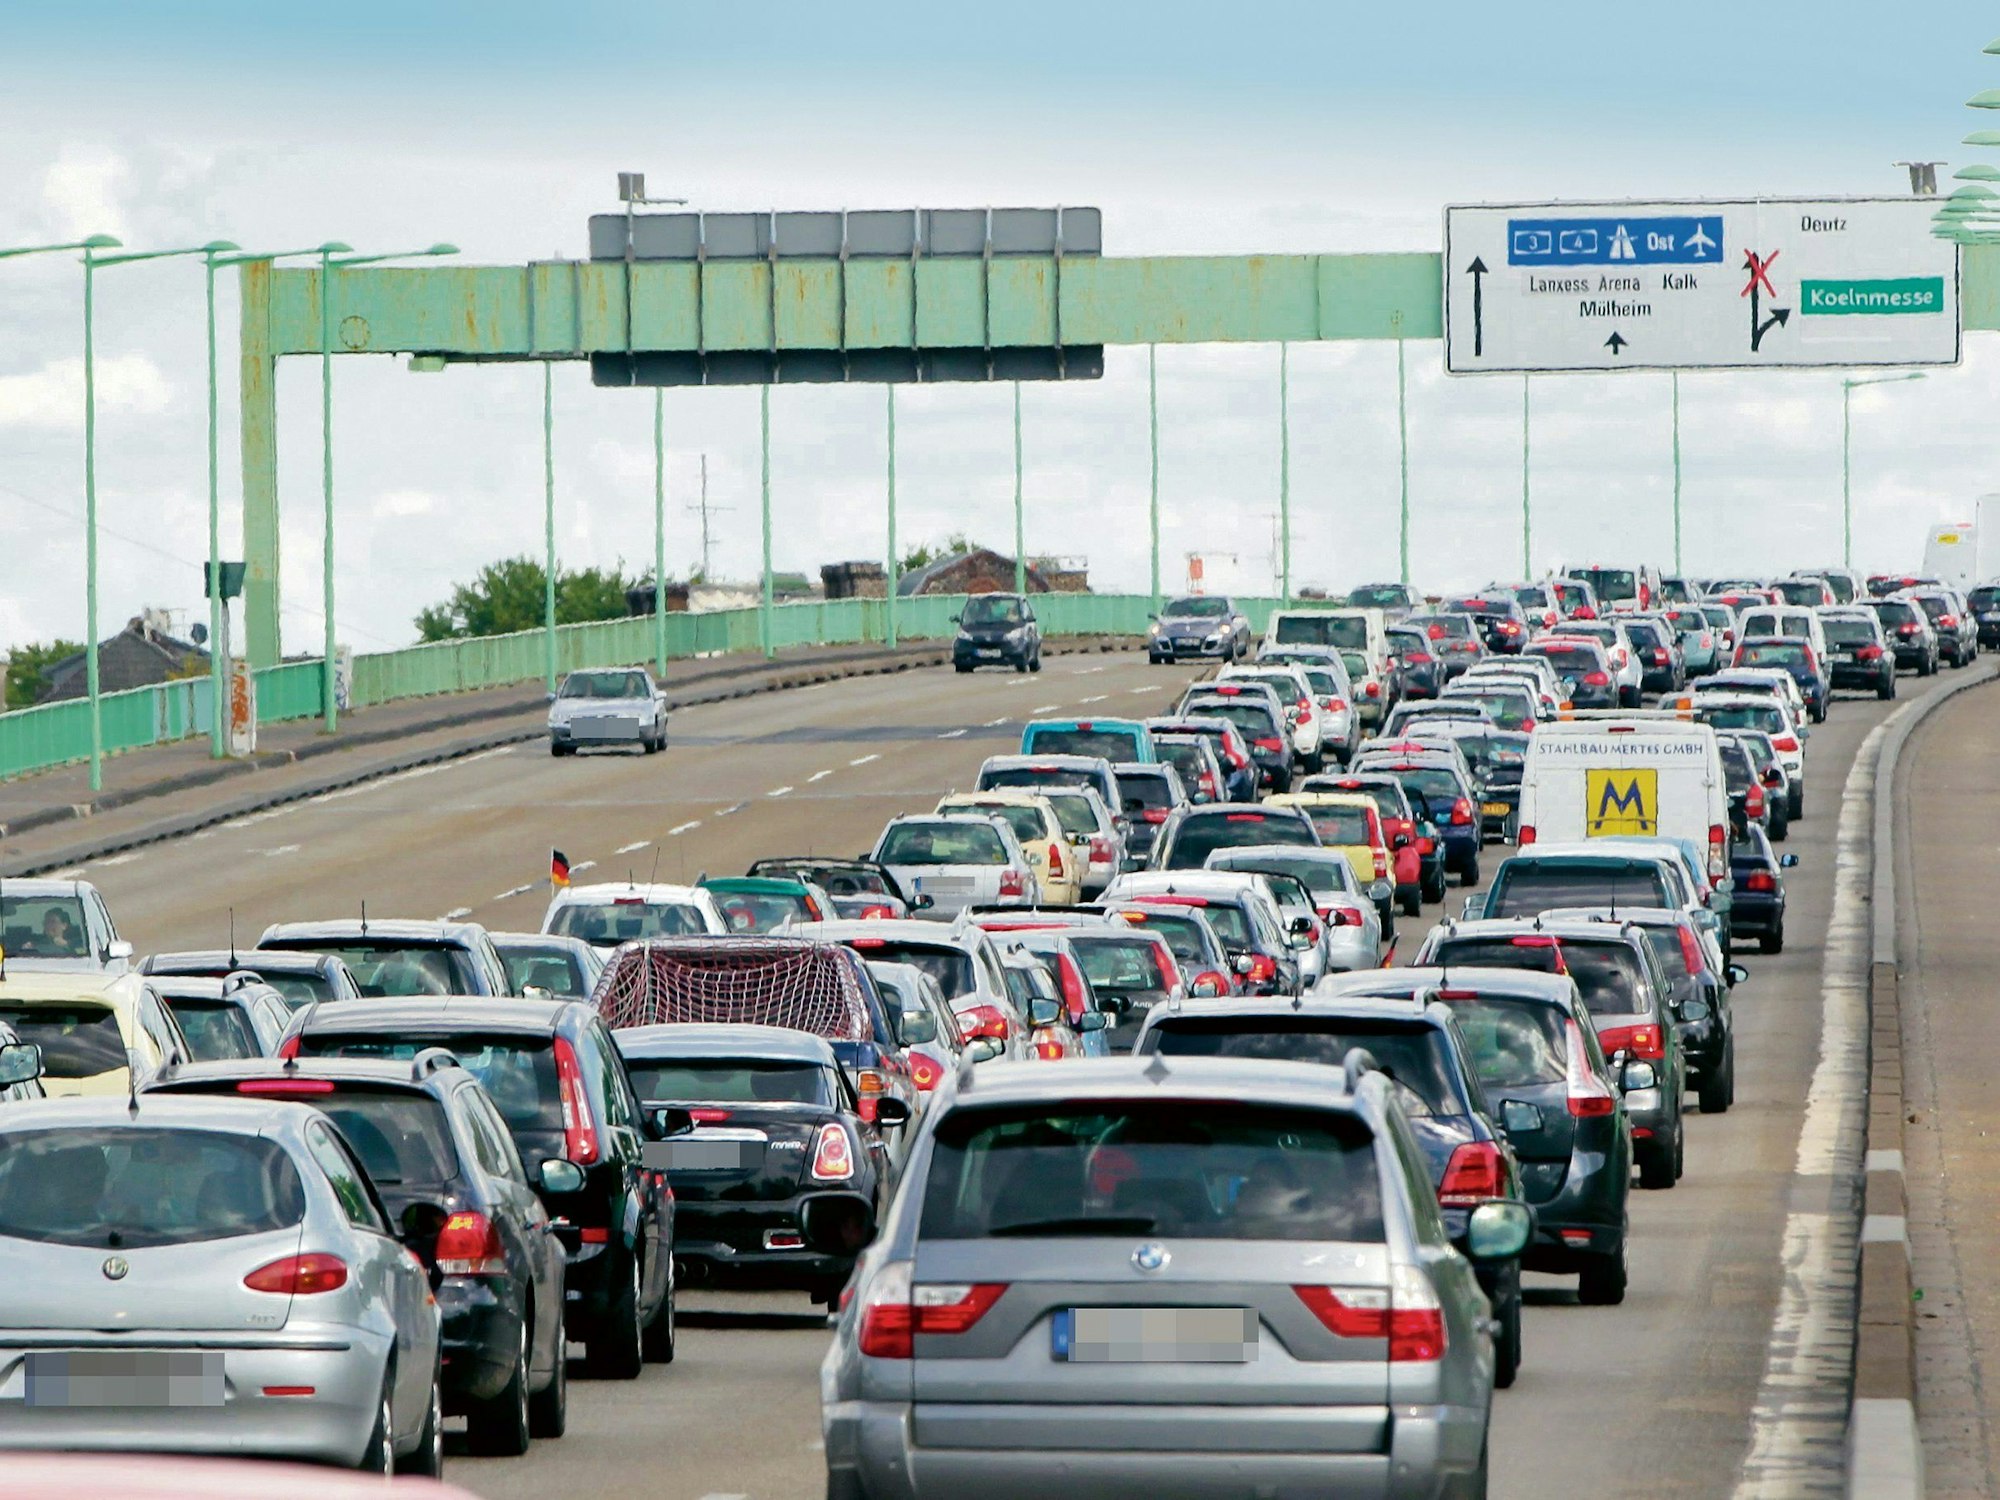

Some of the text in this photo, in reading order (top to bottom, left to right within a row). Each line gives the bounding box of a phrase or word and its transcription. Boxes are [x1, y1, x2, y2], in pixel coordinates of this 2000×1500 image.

[1801, 216, 1847, 232] Deutz
[1529, 232, 1675, 251] 3 4 Ost
[1530, 273, 1698, 293] Lanxess Arena Kalk
[1811, 288, 1934, 306] Koelnmesse
[1579, 299, 1652, 317] Mülheim
[1539, 743, 1608, 755] STAHLBAU
[1663, 744, 1703, 755] GMBH
[1594, 777, 1648, 830] M
